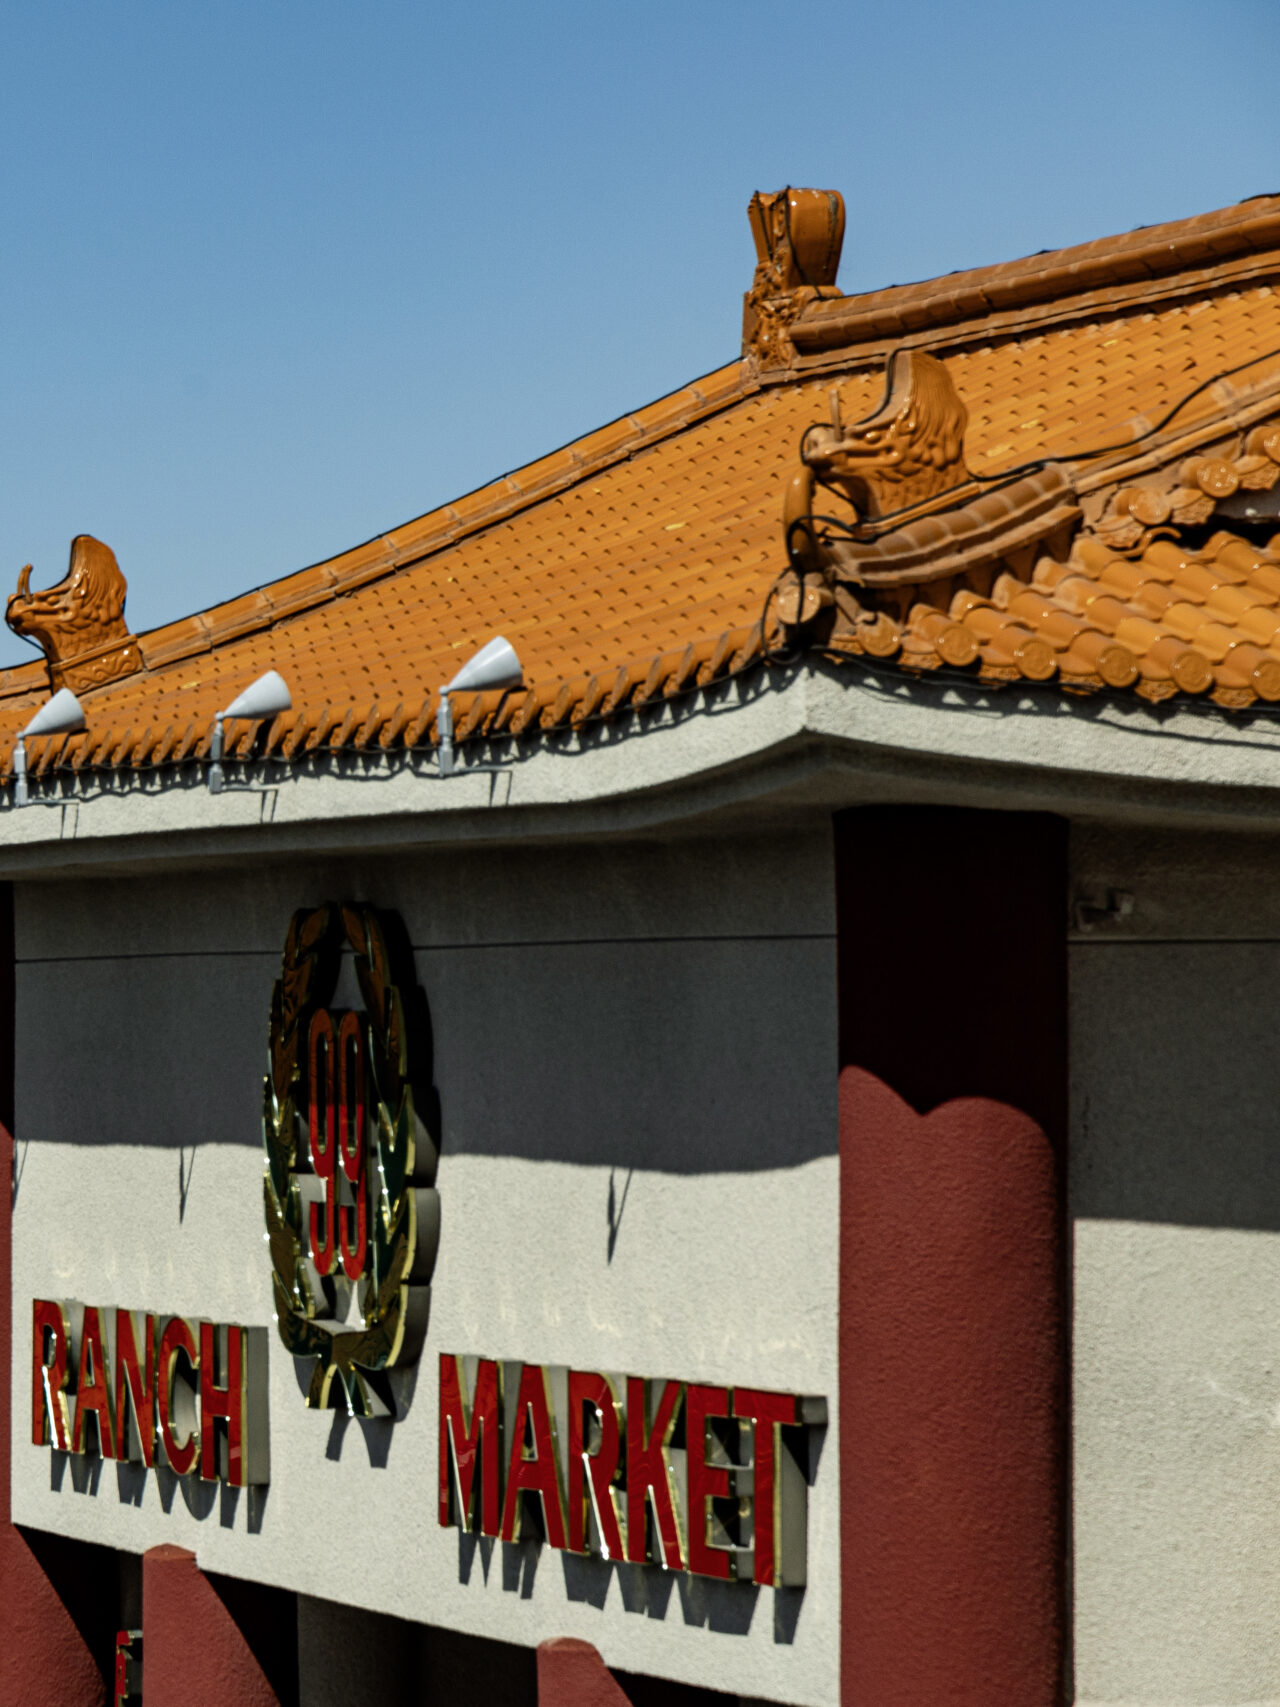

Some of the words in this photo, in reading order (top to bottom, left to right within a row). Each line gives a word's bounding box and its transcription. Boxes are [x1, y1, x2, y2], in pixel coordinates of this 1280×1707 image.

[307, 1007, 368, 1281] 99
[32, 1298, 252, 1488] RANCH
[438, 1352, 805, 1588] MARKET
